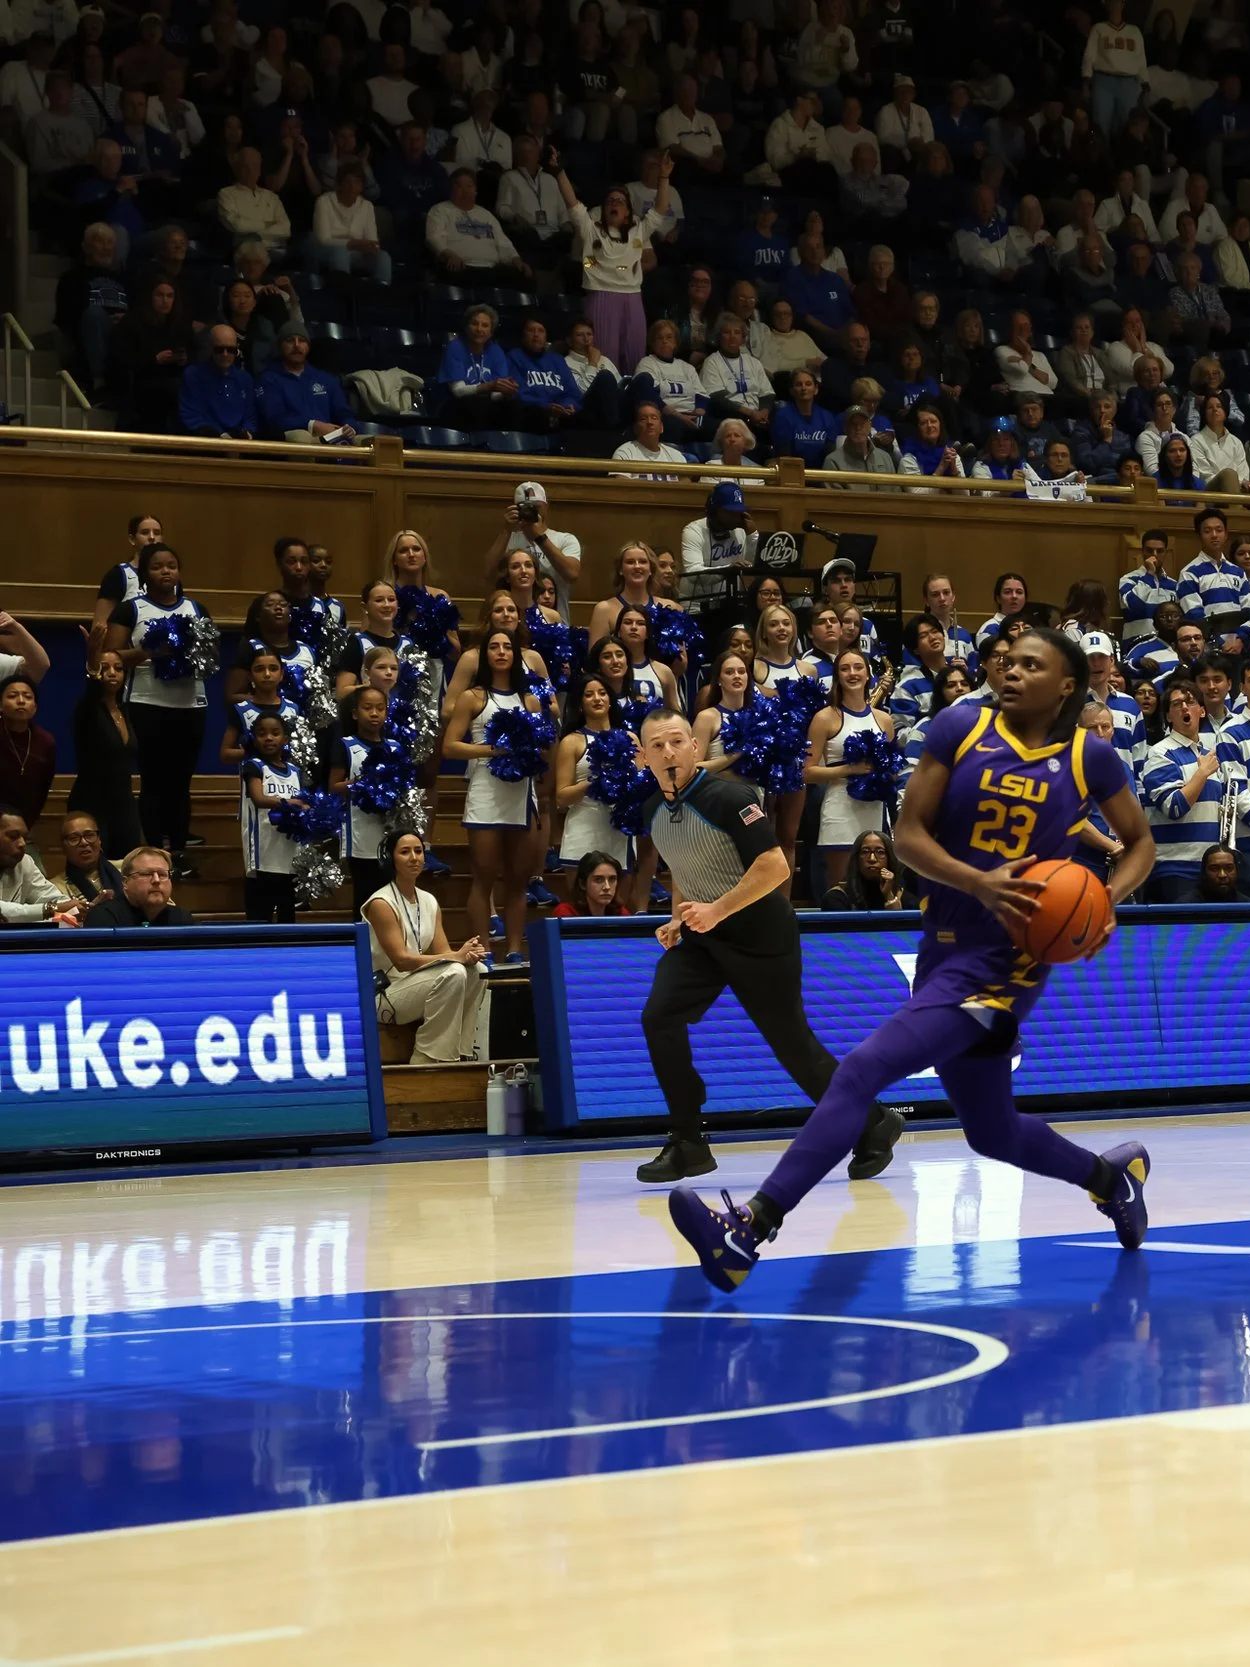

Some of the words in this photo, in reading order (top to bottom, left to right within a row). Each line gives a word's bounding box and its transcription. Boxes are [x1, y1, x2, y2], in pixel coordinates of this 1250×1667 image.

[526, 370, 565, 391] DUKE
[712, 541, 742, 561] Duke
[979, 769, 1049, 803] LSU
[969, 799, 1037, 859] 23
[0, 989, 347, 1094] uke.edu
[95, 1148, 161, 1159] DAKTRONICS
